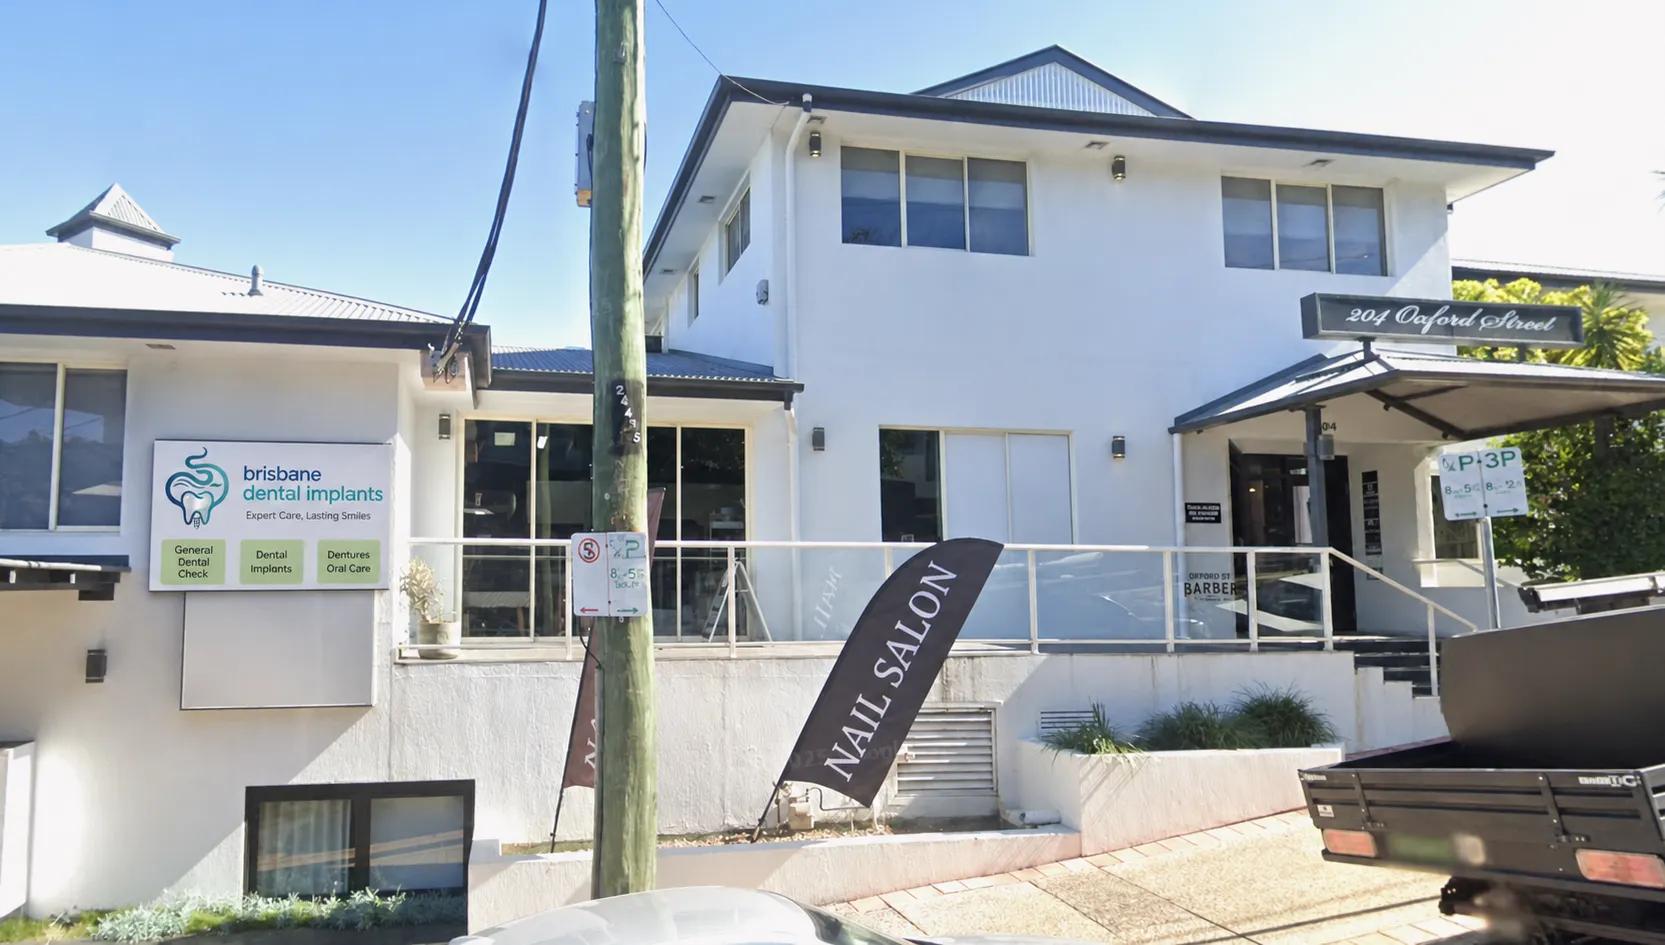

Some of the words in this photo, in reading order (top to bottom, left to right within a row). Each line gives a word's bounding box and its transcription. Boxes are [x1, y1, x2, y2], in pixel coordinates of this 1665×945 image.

[1346, 308, 1391, 326] 204
[1484, 450, 1516, 468] 3P
[243, 465, 322, 481] brisbane
[242, 485, 301, 502] dental
[306, 485, 383, 504] implants
[246, 510, 276, 522] Expert
[279, 511, 304, 522] Care,
[306, 511, 339, 522] Lasting
[341, 511, 371, 520] Smiles
[174, 545, 213, 555] General
[256, 550, 288, 559] Dental
[327, 550, 370, 560] Dentures
[178, 557, 210, 567] Dental
[178, 569, 208, 579] Check
[250, 564, 292, 575] Implants
[326, 564, 347, 573] Oral
[349, 564, 371, 573] Care
[1221, 572, 1230, 580] ST
[1184, 582, 1237, 596] BARBER
[824, 693, 891, 782] NAIL
[873, 560, 957, 688] SALON
